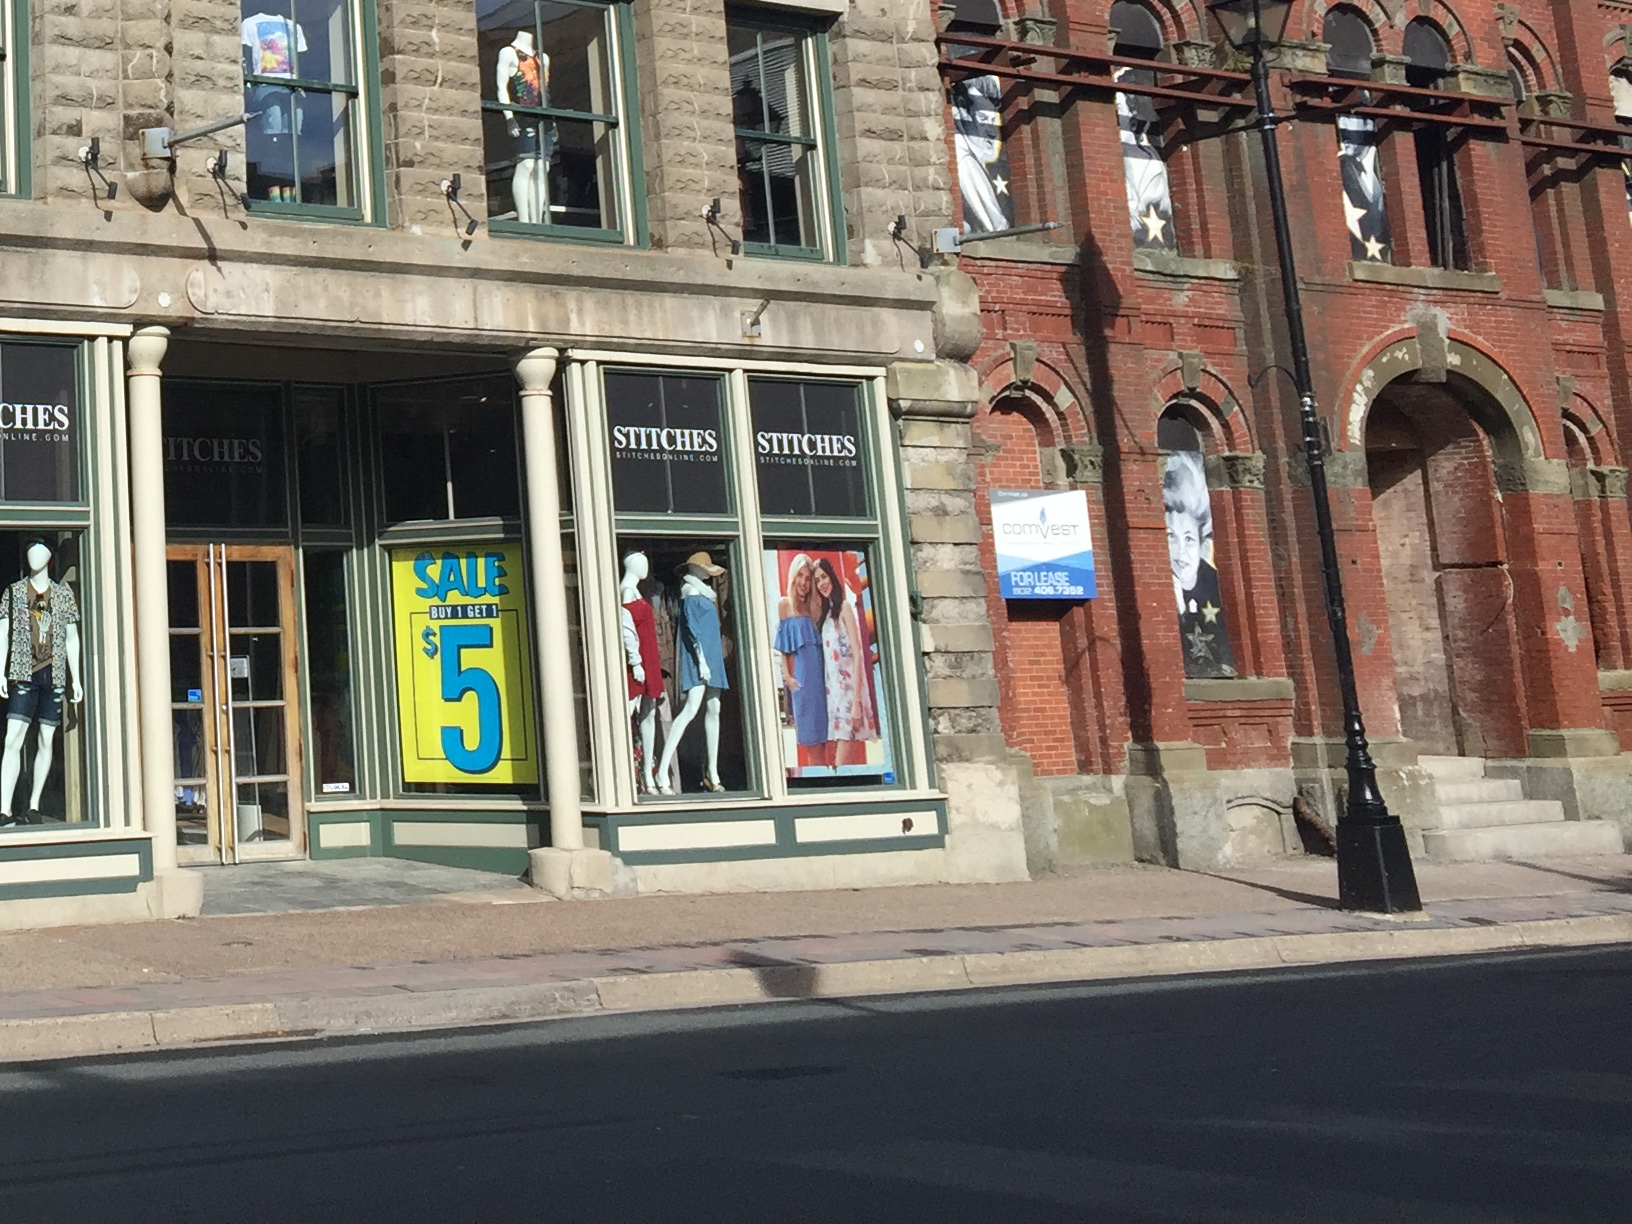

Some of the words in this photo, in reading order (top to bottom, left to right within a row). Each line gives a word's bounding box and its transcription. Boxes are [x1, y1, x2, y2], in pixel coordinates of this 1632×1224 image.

[163, 437, 262, 463] ITCHES
[613, 425, 718, 452] STITCHES
[757, 431, 857, 457] STITCHES
[413, 551, 510, 603] SALE
[1011, 571, 1034, 586] FOR
[1035, 571, 1070, 586] LEASE
[431, 606, 452, 618] BUY
[457, 606, 462, 618] 1
[467, 605, 487, 617] GET
[492, 605, 497, 617] 1
[421, 624, 503, 775] $5
